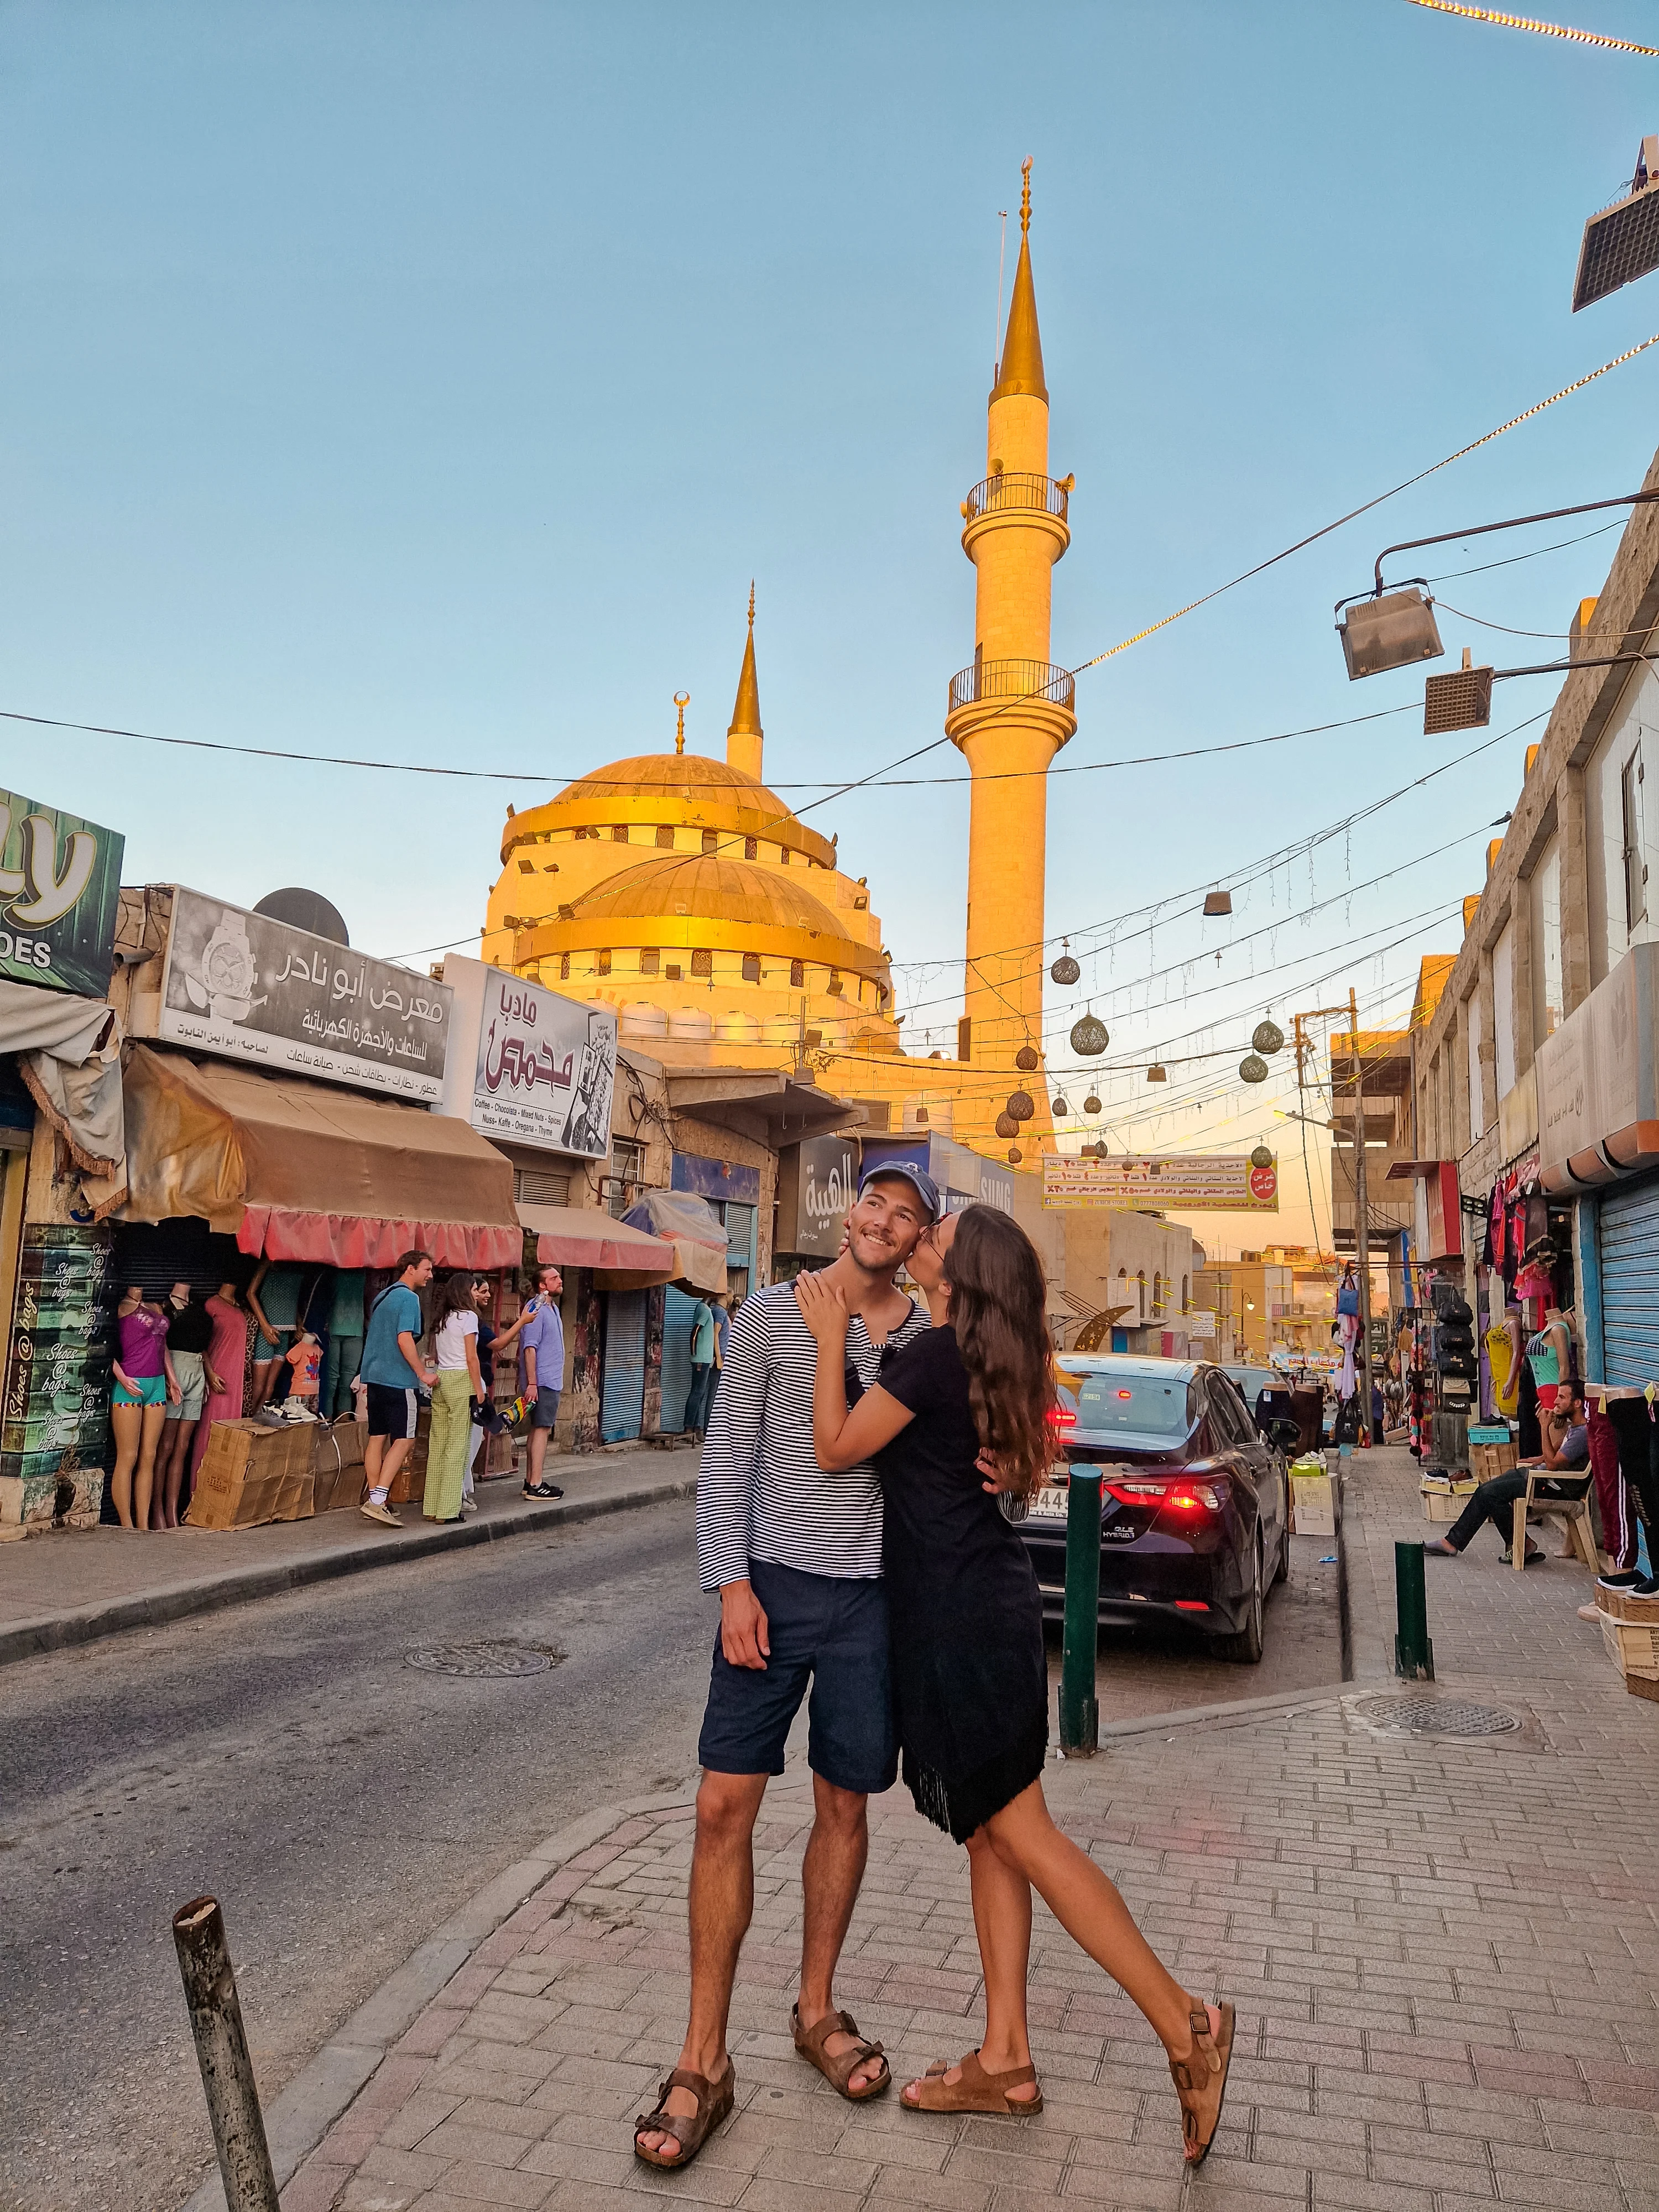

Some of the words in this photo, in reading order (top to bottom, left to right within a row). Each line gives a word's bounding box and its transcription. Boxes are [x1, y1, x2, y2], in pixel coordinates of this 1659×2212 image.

[275, 951, 328, 987] نادر
[332, 960, 367, 1004] أبو
[369, 981, 443, 1024] معرض
[499, 983, 537, 1026] مادبا
[302, 1008, 352, 1040] الكهربائية
[353, 1022, 394, 1056] والأجهزة
[395, 1036, 427, 1061] للساعات
[287, 1049, 311, 1065] ساعات
[313, 1055, 333, 1071] صيانة
[342, 1063, 360, 1076] شحن
[362, 1067, 386, 1083] بطاقات
[392, 1073, 414, 1089] نظارات
[419, 1082, 437, 1095] عطور
[474, 1098, 490, 1110] Coffee
[521, 1109, 534, 1119] Mixed
[535, 1112, 544, 1121] Nuts
[547, 1115, 561, 1125] Spices
[539, 1125, 552, 1137] Thyme
[1253, 1172, 1275, 1181] عرض
[1255, 1182, 1274, 1191] خاص
[91, 1243, 111, 1255] Shoes
[55, 1262, 79, 1276] Shoes
[86, 1266, 105, 1281] bags
[51, 1287, 72, 1302] bags
[81, 1301, 103, 1313] Shoes
[78, 1325, 97, 1339] bags
[9, 1364, 27, 1422] Shoes
[19, 1282, 38, 1332] bags
[46, 1343, 78, 1361] Shoes
[41, 1376, 70, 1398] bags
[80, 1383, 102, 1396] Shoes
[41, 1411, 65, 1426] Shoes
[76, 1408, 96, 1423] bags
[38, 1439, 59, 1454] bags
